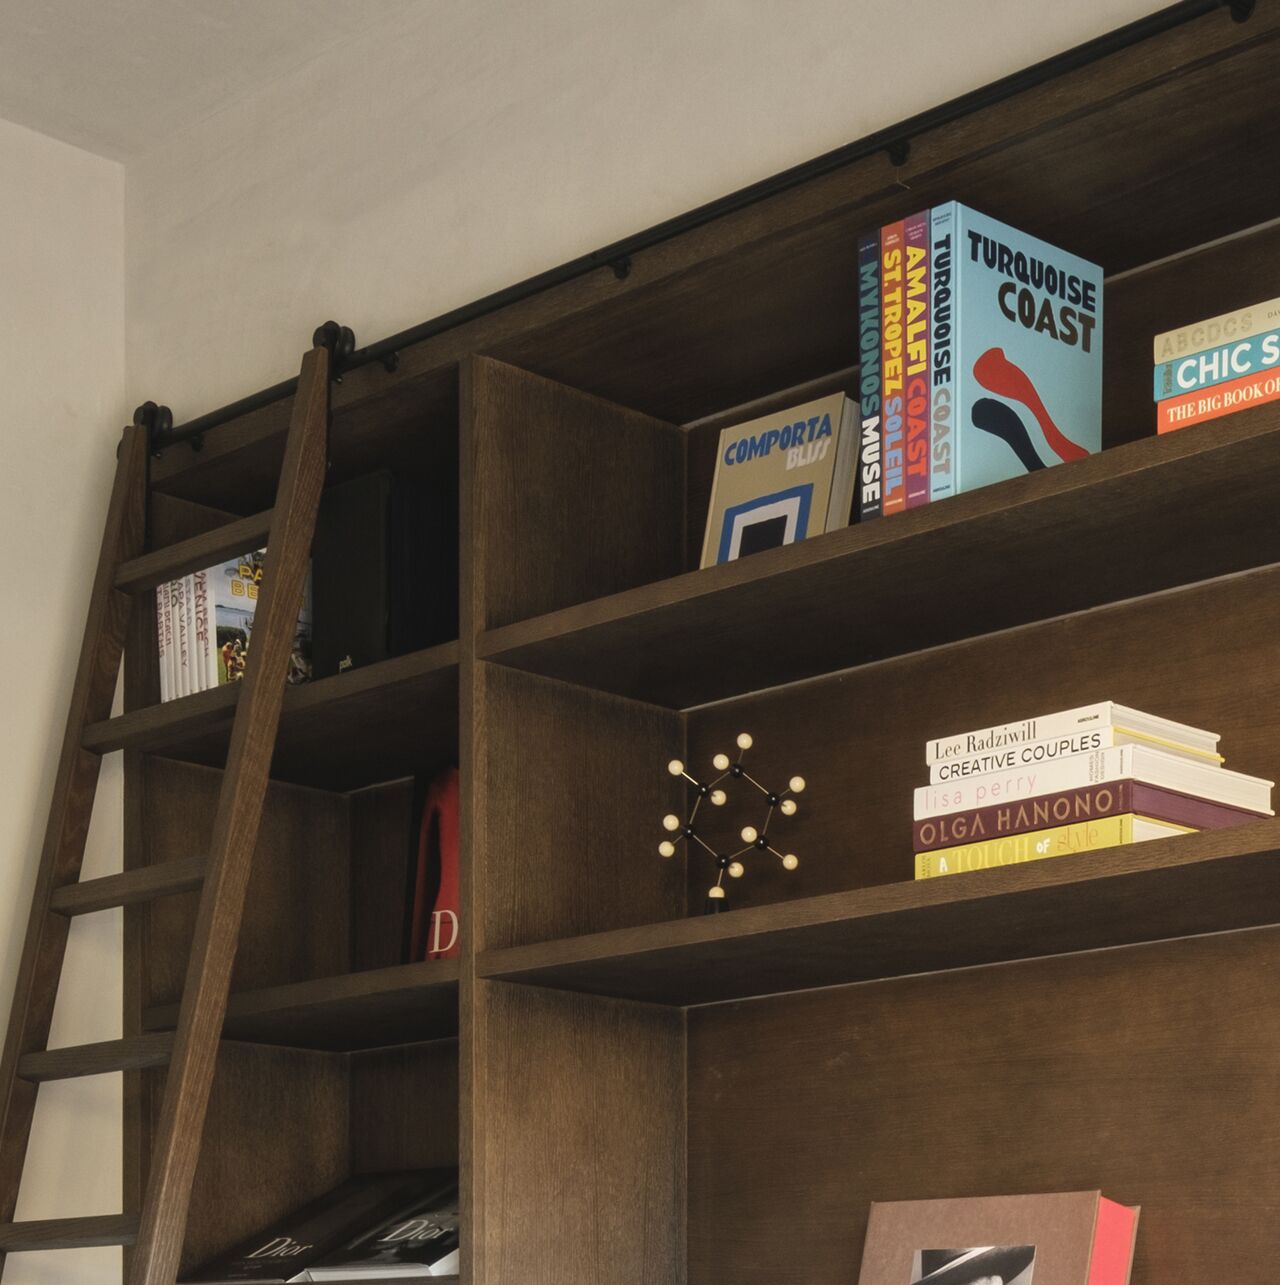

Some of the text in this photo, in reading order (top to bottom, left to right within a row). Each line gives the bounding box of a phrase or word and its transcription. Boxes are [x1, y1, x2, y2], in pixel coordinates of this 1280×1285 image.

[884, 249, 902, 287] ST.
[968, 230, 1097, 312] TURQUOISE
[906, 246, 927, 376] AMALFI
[933, 234, 952, 387] TURQUOISE
[997, 281, 1096, 354] COAST
[1161, 313, 1253, 358] ABCDCS
[860, 260, 880, 416] MYKONOS
[884, 287, 903, 396] TROPEZ
[1176, 343, 1251, 390] CHIC
[906, 377, 928, 477] COAST
[1167, 403, 1196, 423] THE
[1198, 396, 1222, 416] BIG
[1224, 386, 1263, 408] BOOK
[724, 413, 832, 466] COMPORTA
[786, 438, 830, 472] BLISS
[885, 397, 904, 496] SOLEIL
[932, 387, 952, 477] COAST
[862, 416, 880, 504] MUSE
[179, 614, 187, 668] VALLEY
[935, 739, 962, 761] Lee
[966, 721, 1037, 753] Radziwill
[939, 751, 1016, 781] CREATIVE
[1021, 733, 1101, 763] COUPLES
[920, 814, 986, 845] OLGA
[998, 789, 1112, 831] HANONO
[925, 774, 1038, 812] lisa perry
[939, 857, 948, 872] A
[952, 837, 1030, 873] TOUCH
[1057, 823, 1098, 853] style
[244, 1238, 313, 1259] Dior
[377, 1219, 455, 1242] Dior
